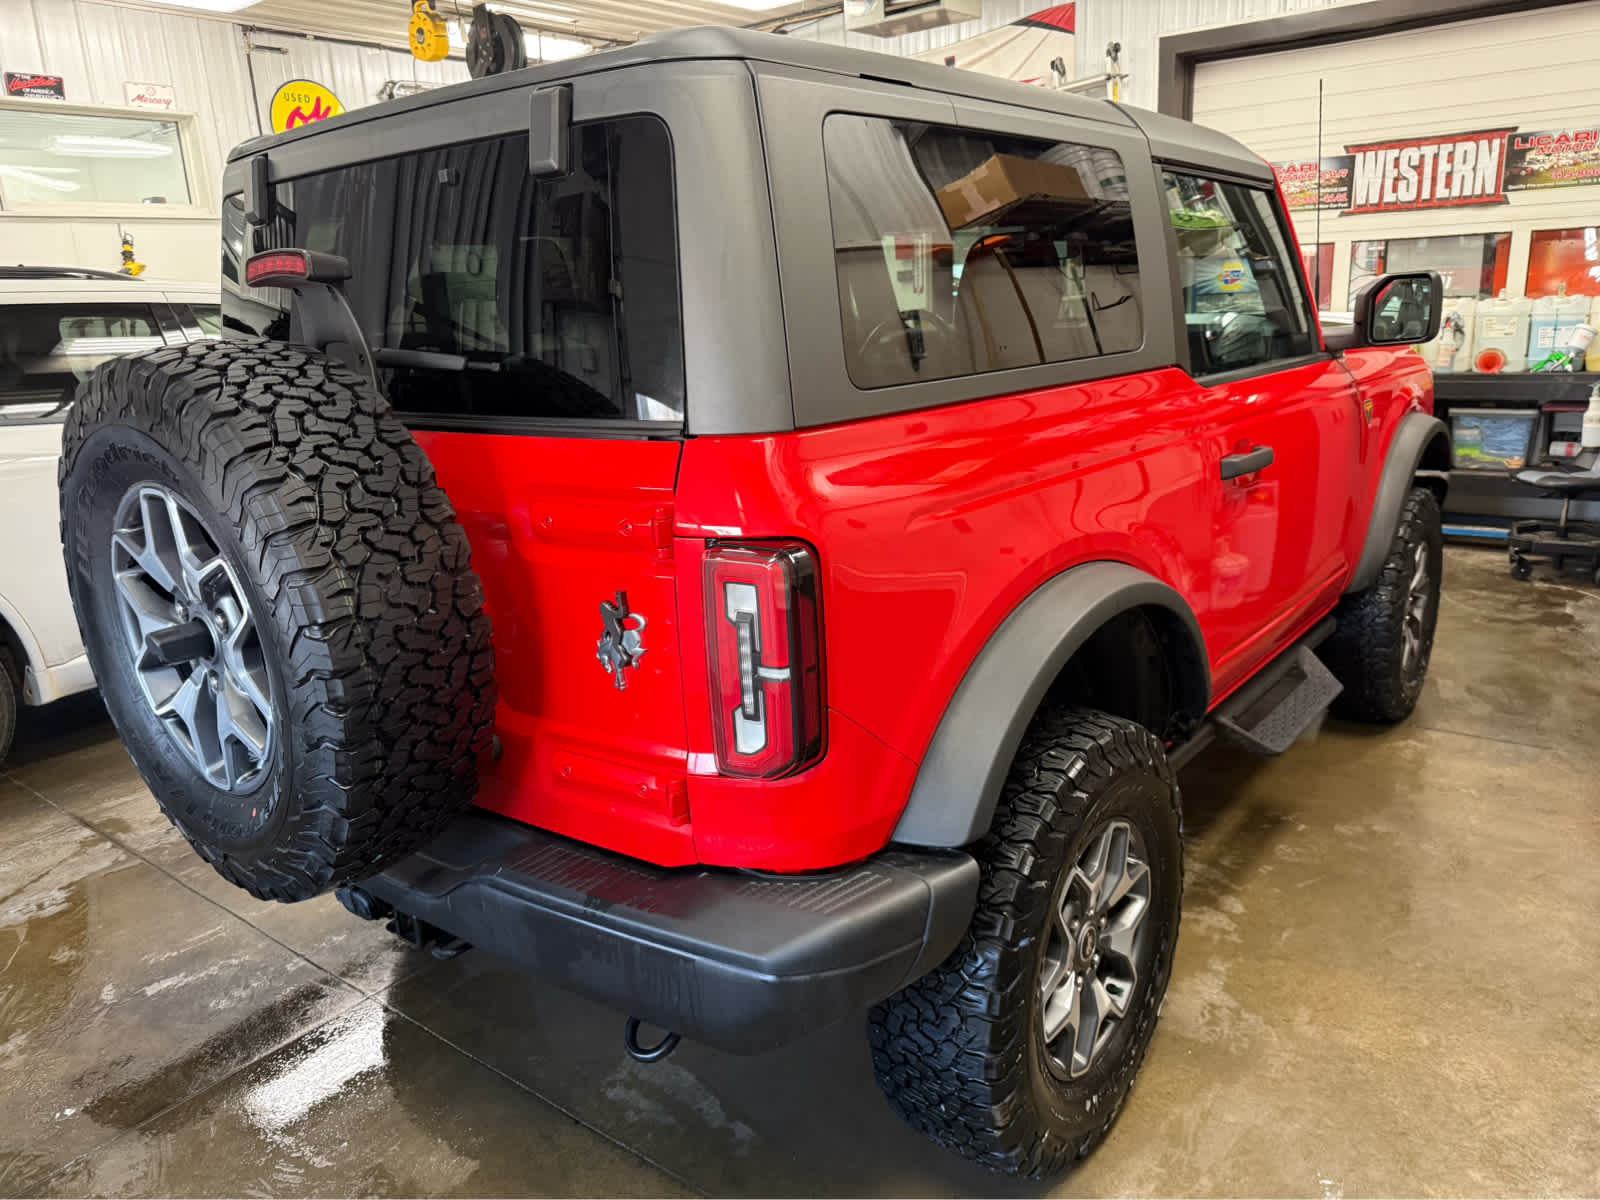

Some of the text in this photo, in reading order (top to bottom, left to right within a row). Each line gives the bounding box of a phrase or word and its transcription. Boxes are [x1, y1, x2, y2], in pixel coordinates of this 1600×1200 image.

[284, 92, 311, 104] USED
[1514, 130, 1599, 149] LICARI
[1354, 138, 1501, 206] WESTERN
